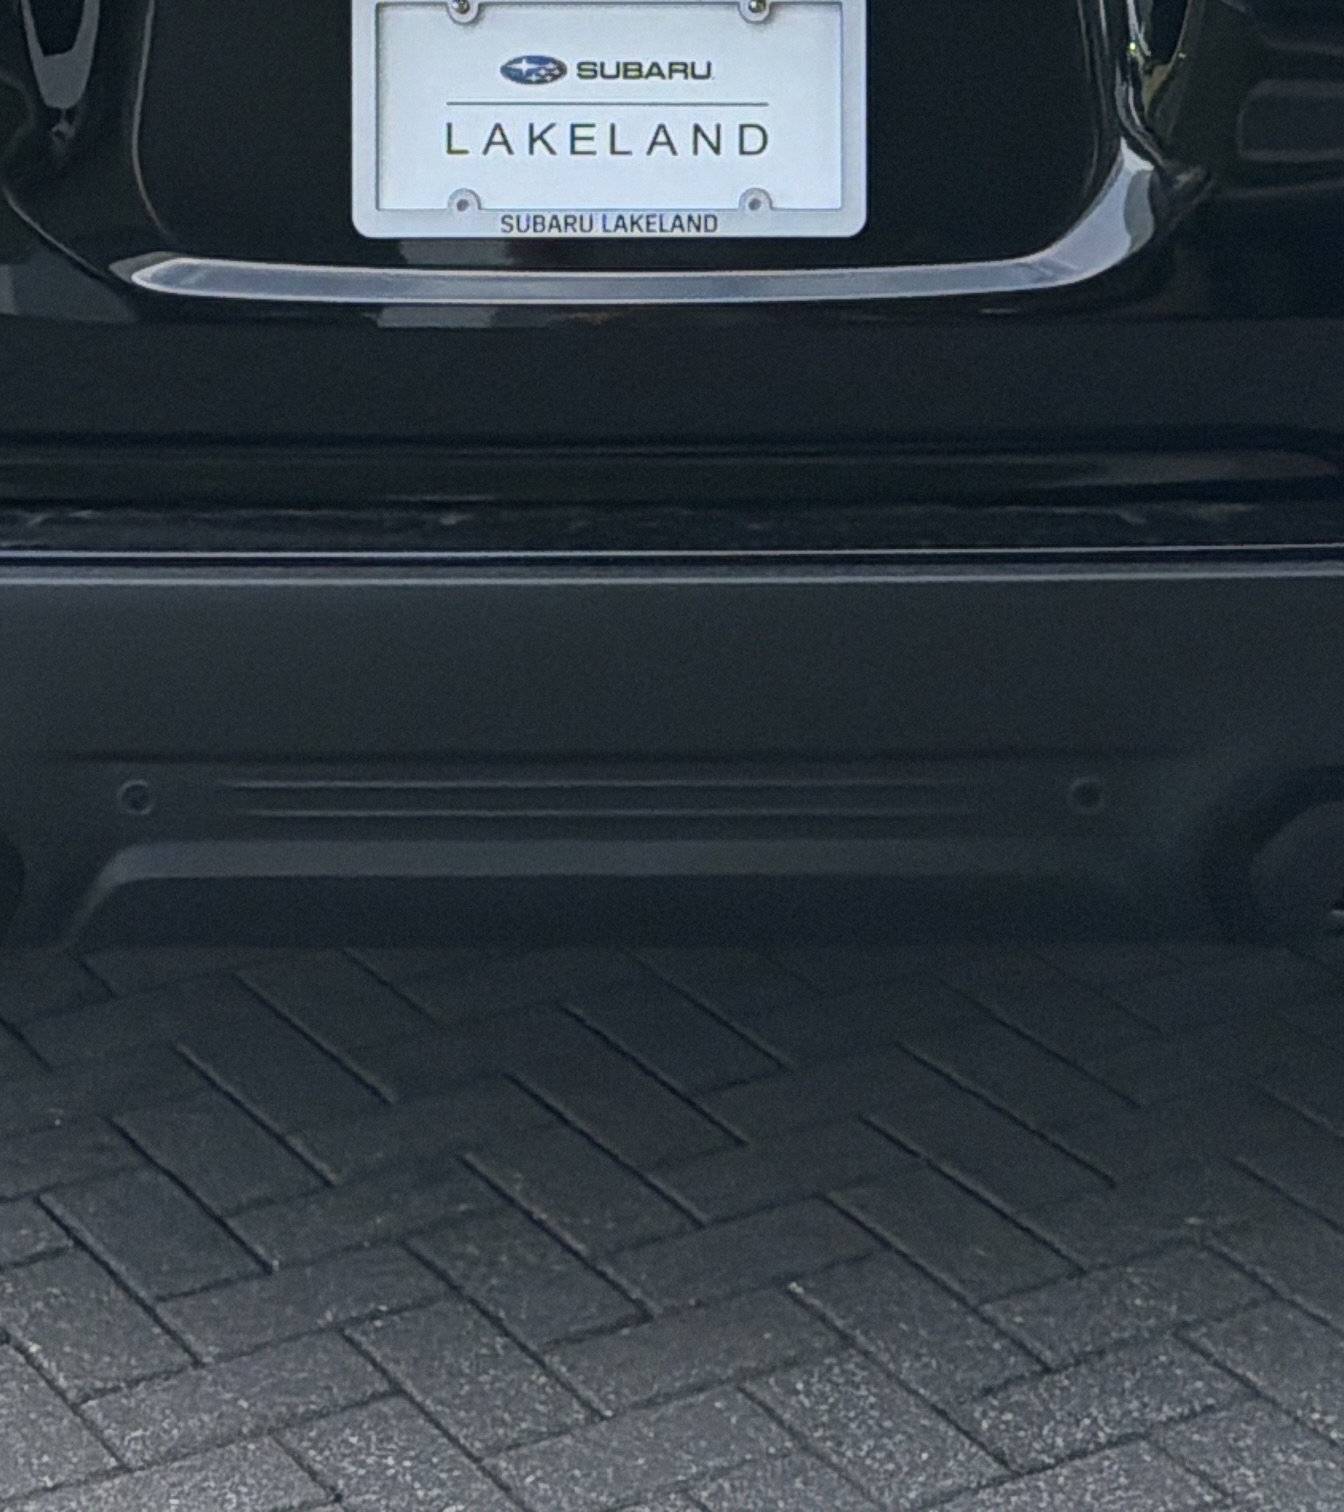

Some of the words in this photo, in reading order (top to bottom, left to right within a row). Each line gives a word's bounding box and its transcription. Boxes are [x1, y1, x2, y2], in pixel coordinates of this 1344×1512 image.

[576, 60, 714, 81] SUBARU
[445, 121, 769, 157] LAKELAND
[500, 213, 595, 234] SUBARU
[601, 213, 719, 234] LAKELAND
